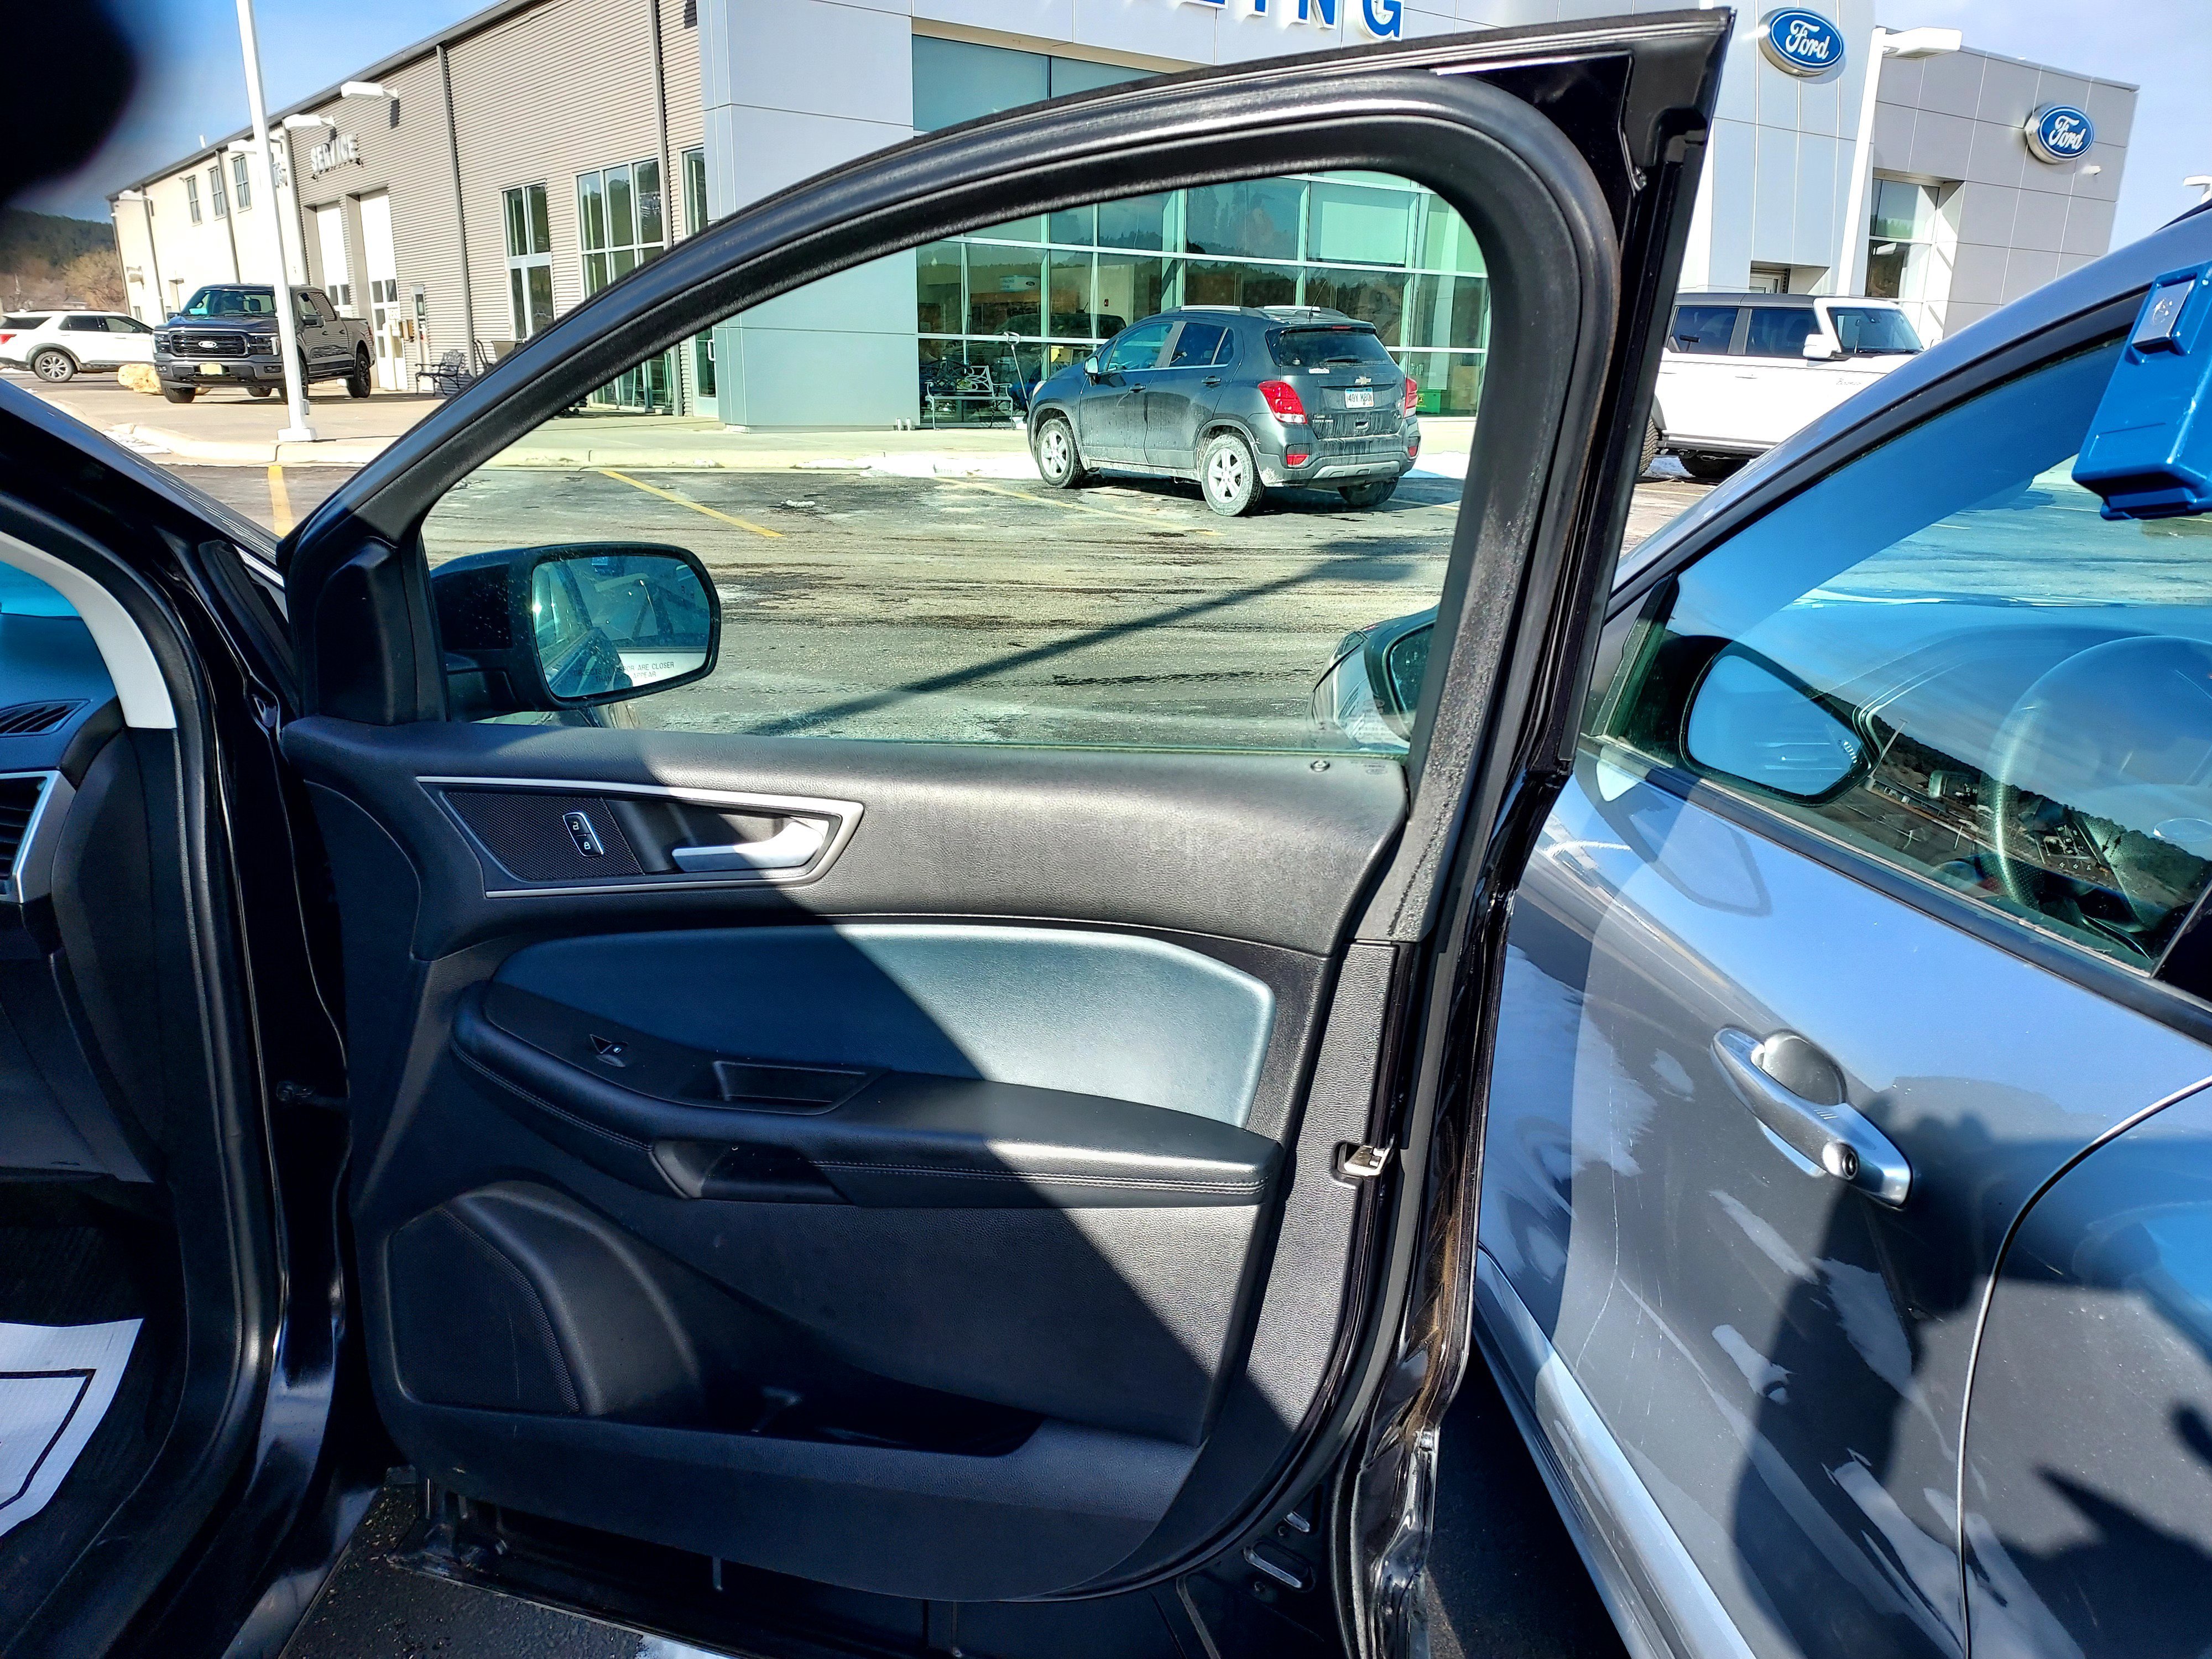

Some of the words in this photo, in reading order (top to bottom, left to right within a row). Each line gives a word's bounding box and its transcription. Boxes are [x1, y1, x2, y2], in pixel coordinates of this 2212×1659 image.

[1785, 20, 1830, 60] Ford
[2048, 116, 2086, 150] Ford
[310, 133, 361, 173] SERVICE
[652, 661, 674, 670] CLOSER
